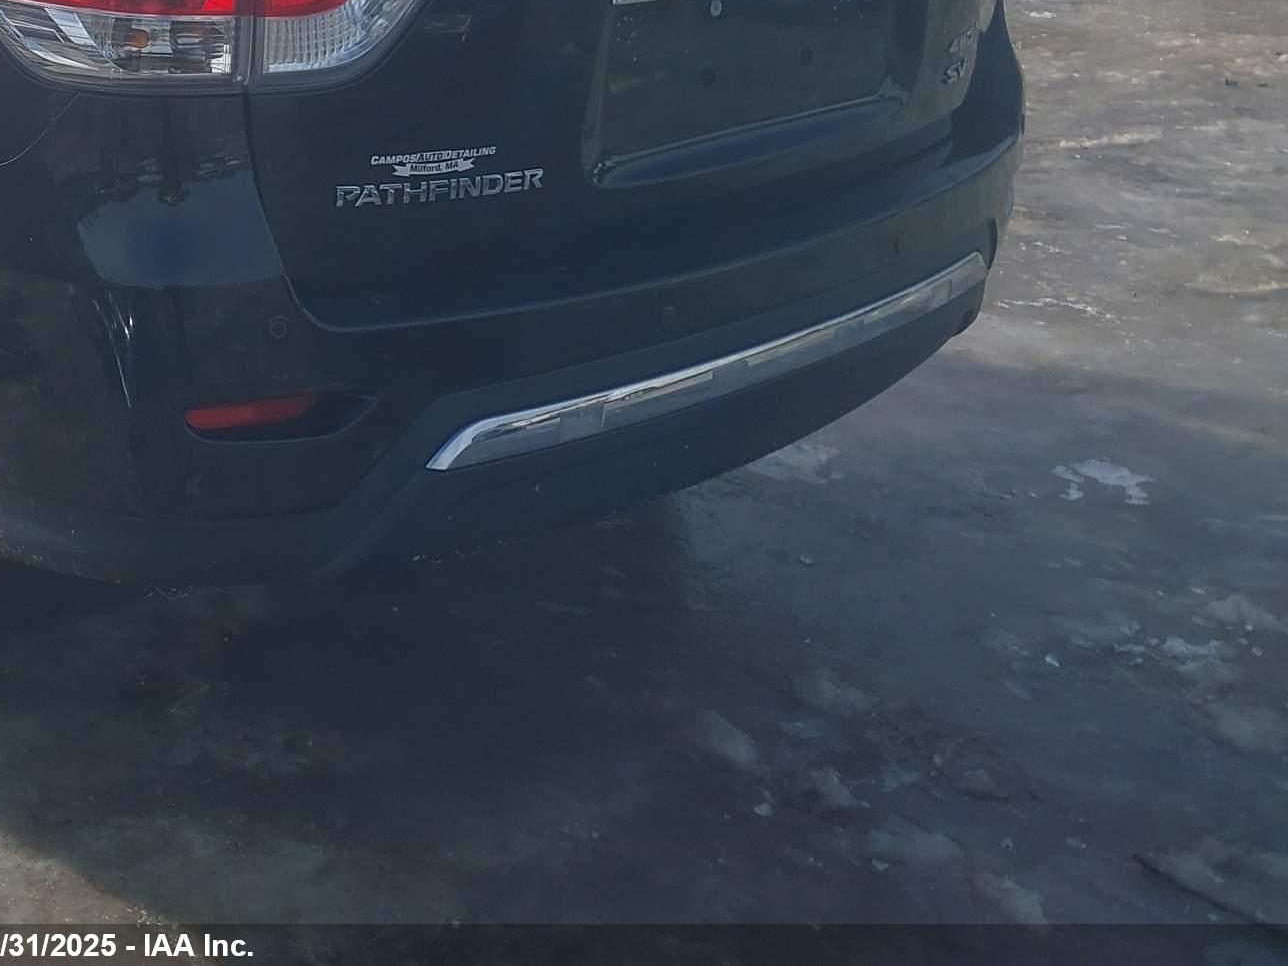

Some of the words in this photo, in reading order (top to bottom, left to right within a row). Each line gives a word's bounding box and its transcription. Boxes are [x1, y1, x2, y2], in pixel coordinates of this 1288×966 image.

[370, 154, 417, 166] CAMPOS
[444, 146, 497, 159] DETAILING
[409, 162, 443, 174] Milford,
[445, 160, 460, 171] MA
[335, 168, 544, 207] PATHFINDER
